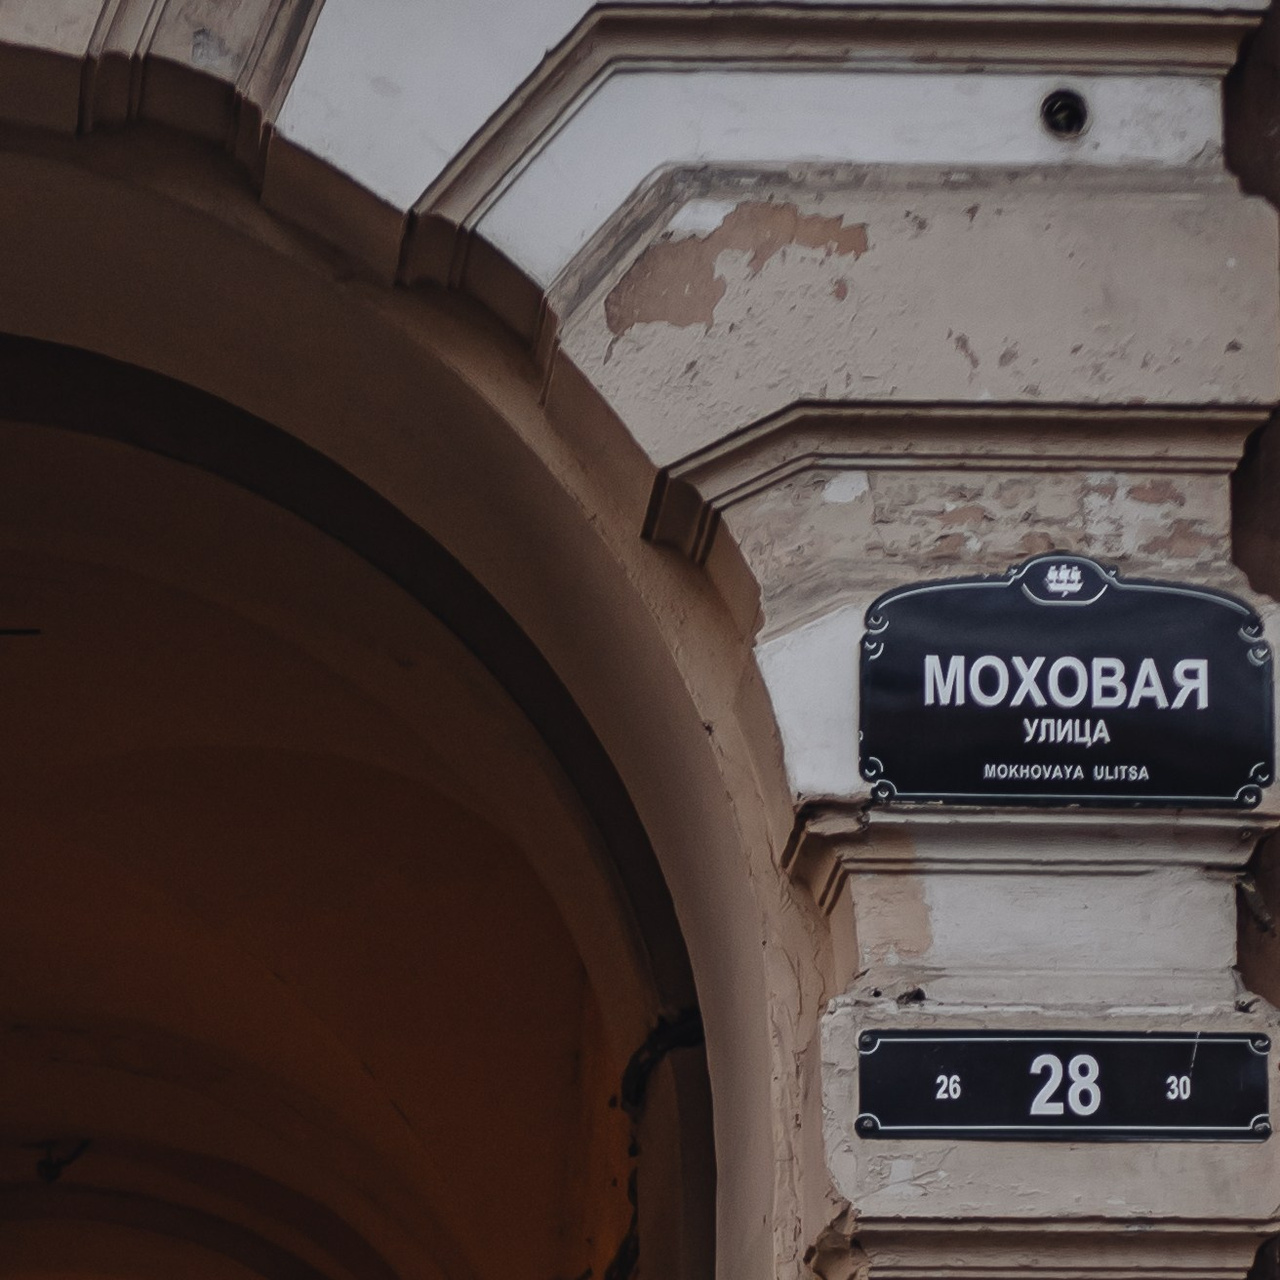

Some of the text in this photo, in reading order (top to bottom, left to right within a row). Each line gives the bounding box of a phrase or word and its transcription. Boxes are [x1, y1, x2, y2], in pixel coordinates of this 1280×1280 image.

[924, 654, 1210, 710] МОХОВАЯ
[1023, 717, 1111, 748] УЛИЦА
[983, 763, 1151, 781] MOKHOVAYA ULITSA
[935, 1053, 1192, 1116] 26 28 30
